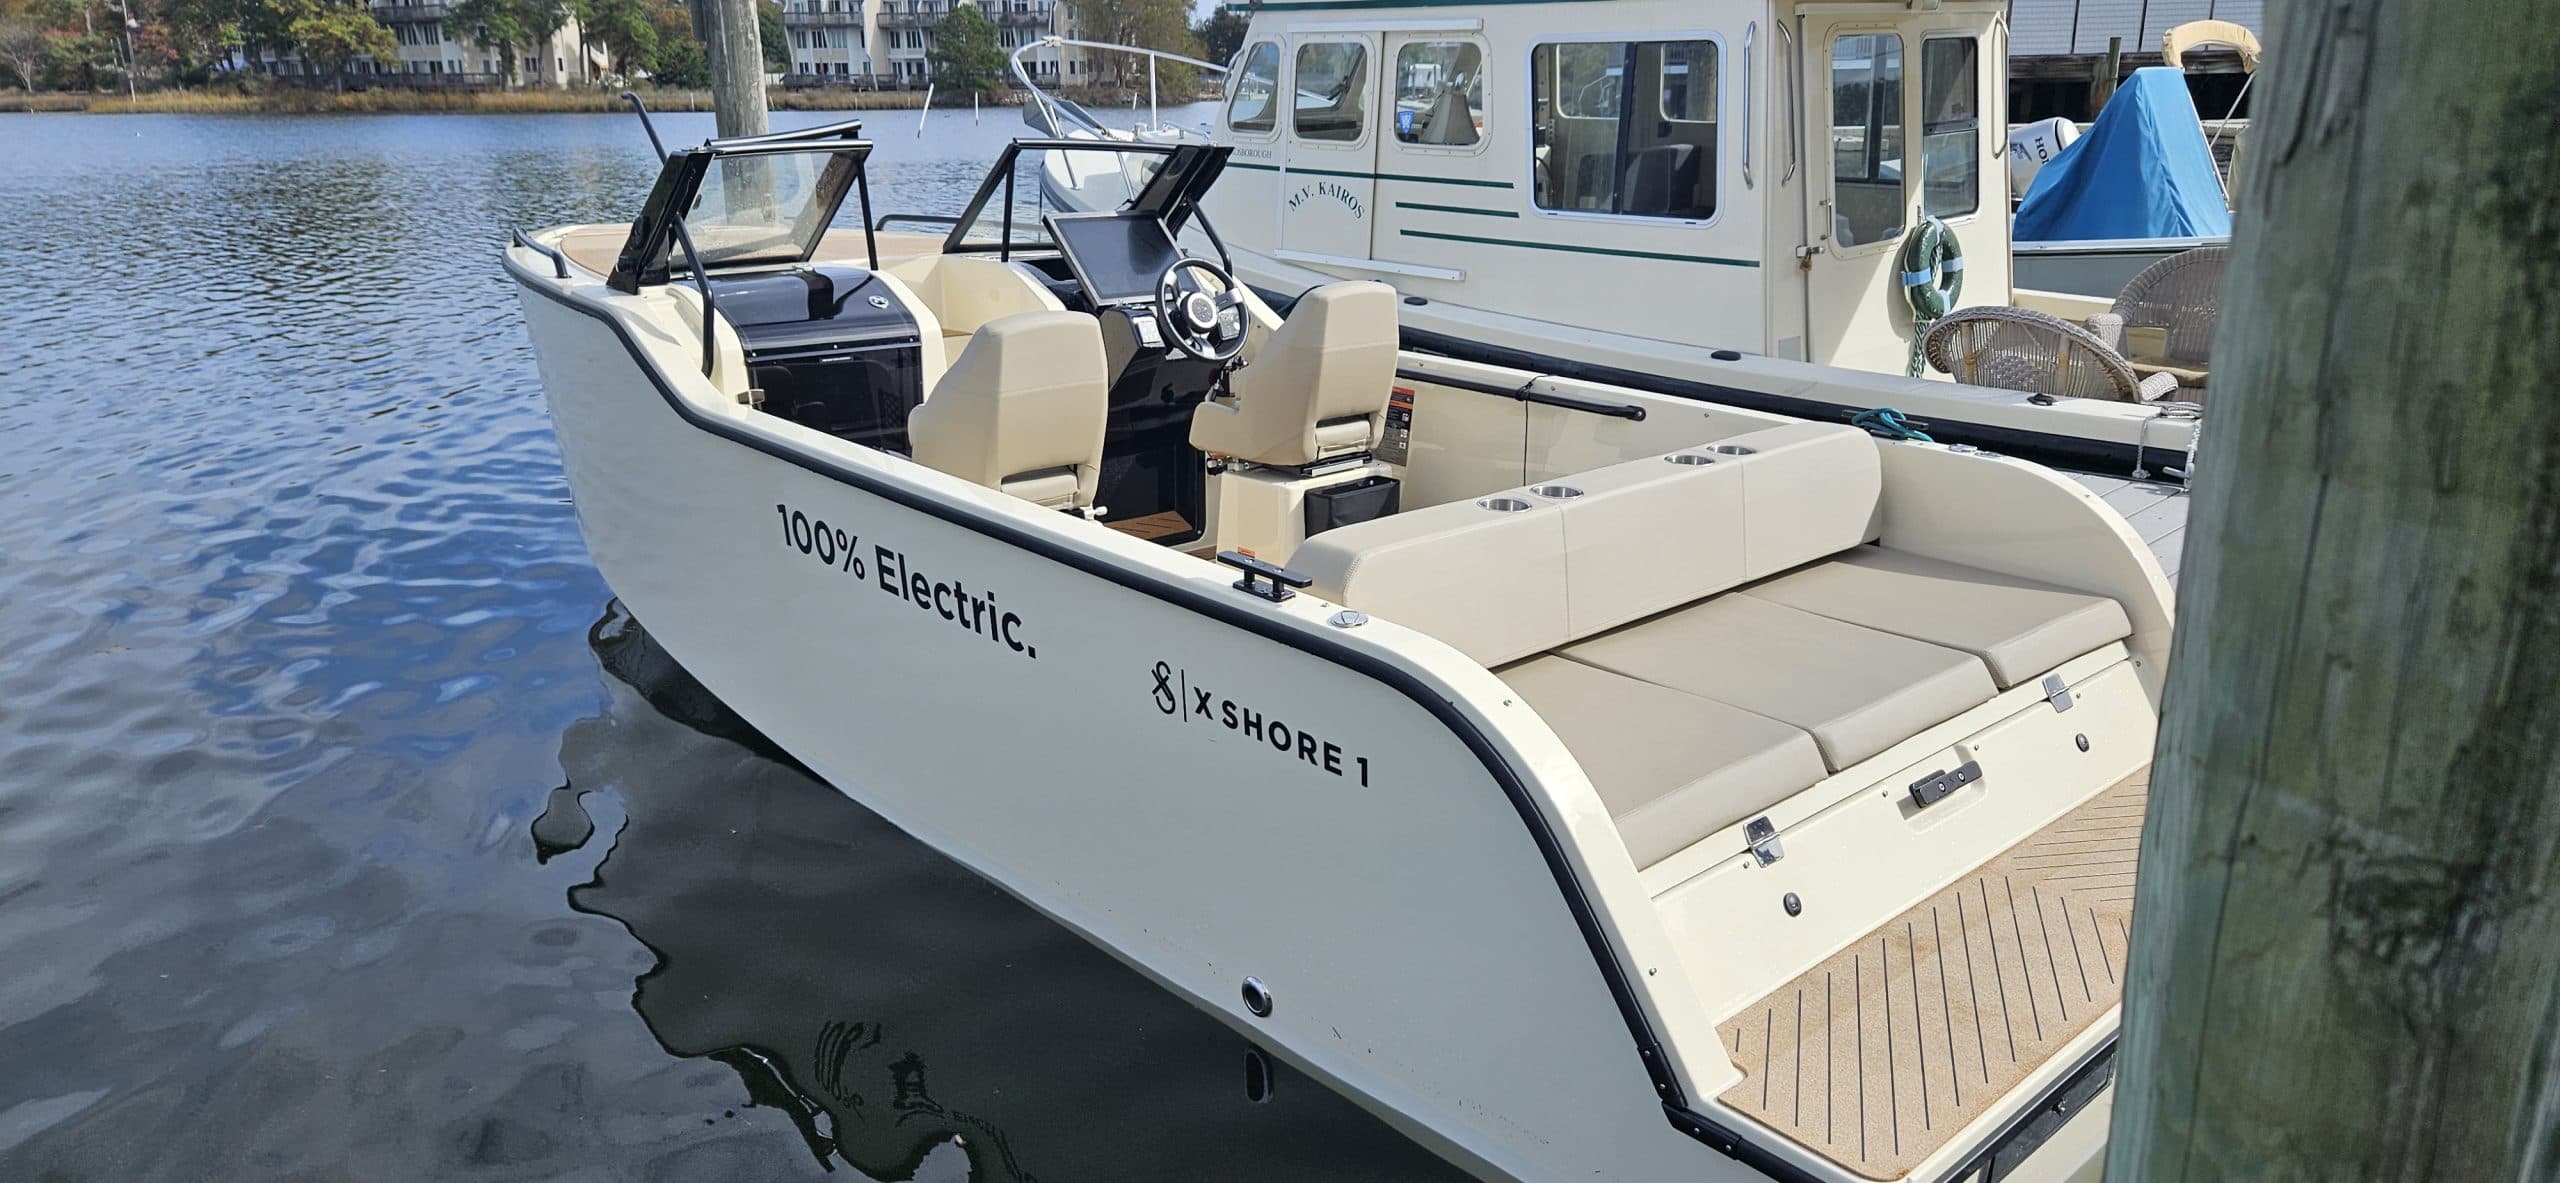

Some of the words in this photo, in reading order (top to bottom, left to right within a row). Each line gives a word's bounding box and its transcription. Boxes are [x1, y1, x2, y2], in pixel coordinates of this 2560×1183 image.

[1288, 184, 1314, 212] M.V.
[1319, 181, 1365, 219] KAIROS
[776, 503, 865, 580] 100%
[874, 544, 1037, 659] Electric.
[1193, 686, 1214, 720] X
[1221, 700, 1343, 777] SHORE
[1356, 756, 1369, 788] 1
